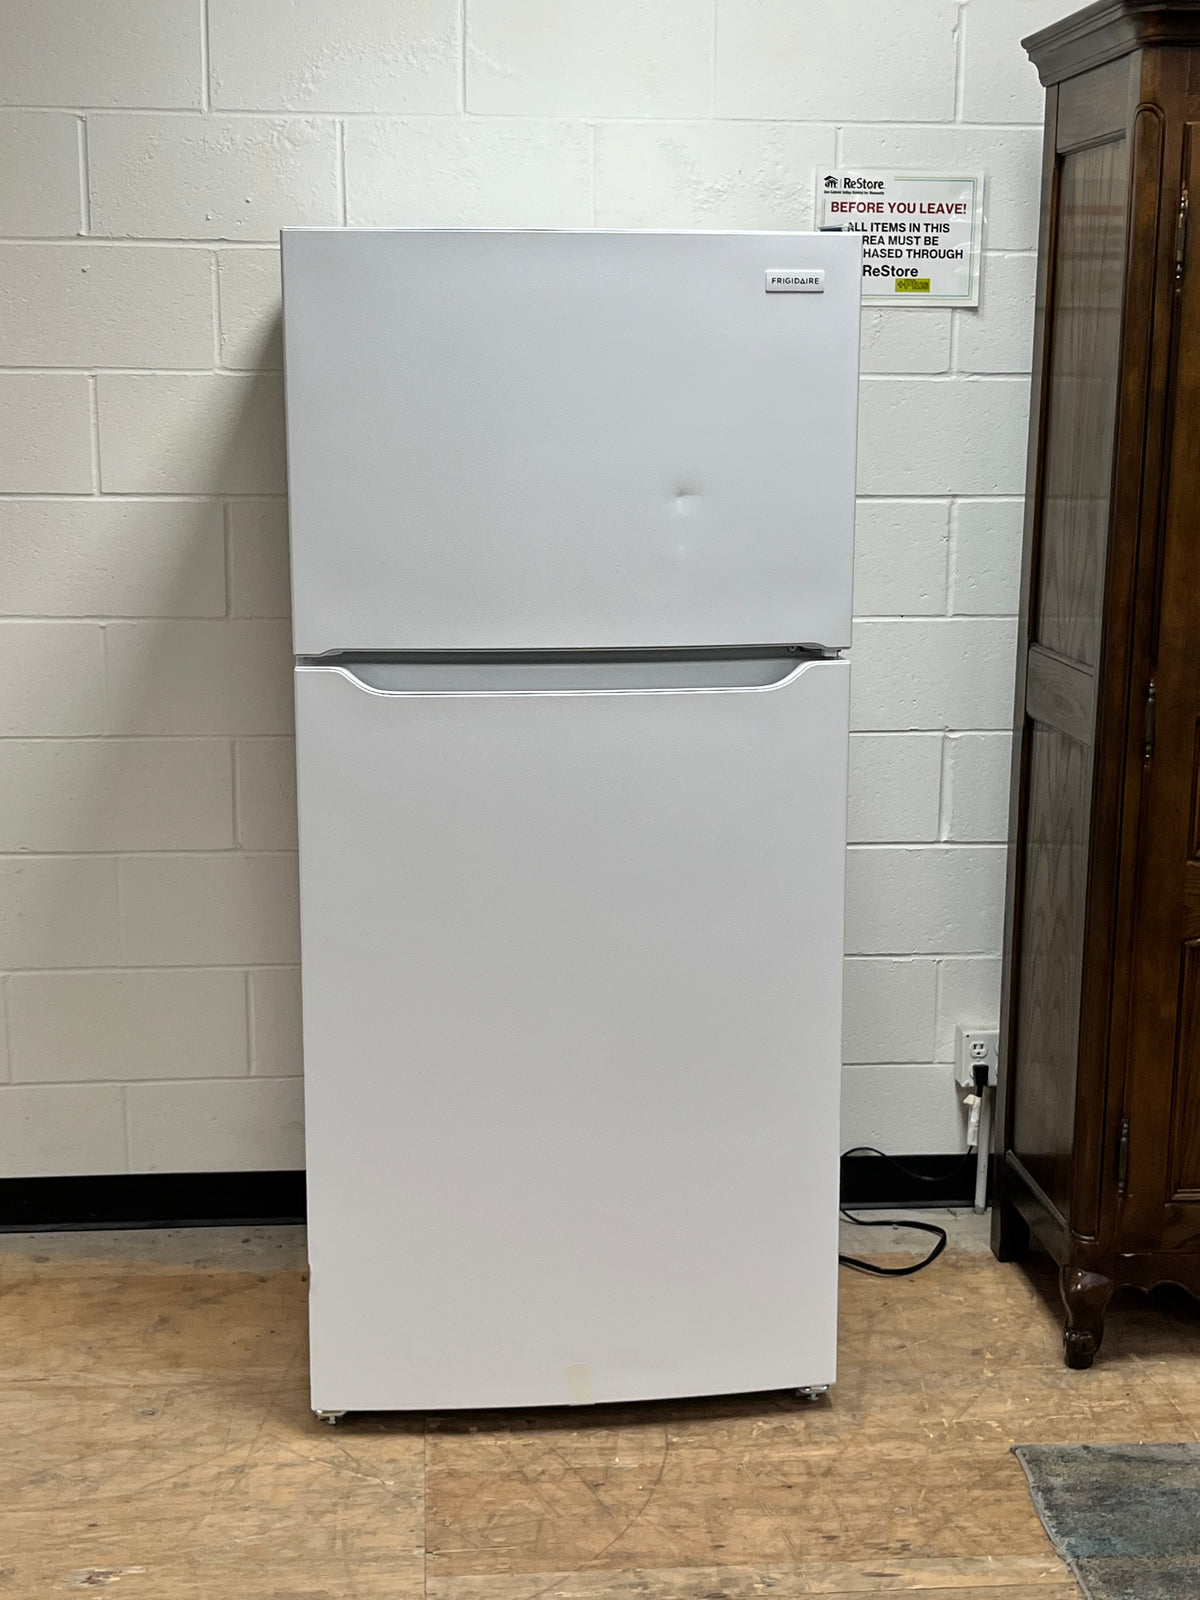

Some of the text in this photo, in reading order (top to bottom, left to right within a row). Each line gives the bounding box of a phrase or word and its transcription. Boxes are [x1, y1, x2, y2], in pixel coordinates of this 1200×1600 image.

[844, 177, 884, 189] ReStore
[831, 201, 967, 214] BEFORE YOU LEAVE!
[848, 222, 950, 233] ALL ITEMS IN THIS
[862, 235, 939, 246] REA MUST BE
[863, 248, 963, 259] HASED THROUGH
[862, 264, 918, 277] ReStore
